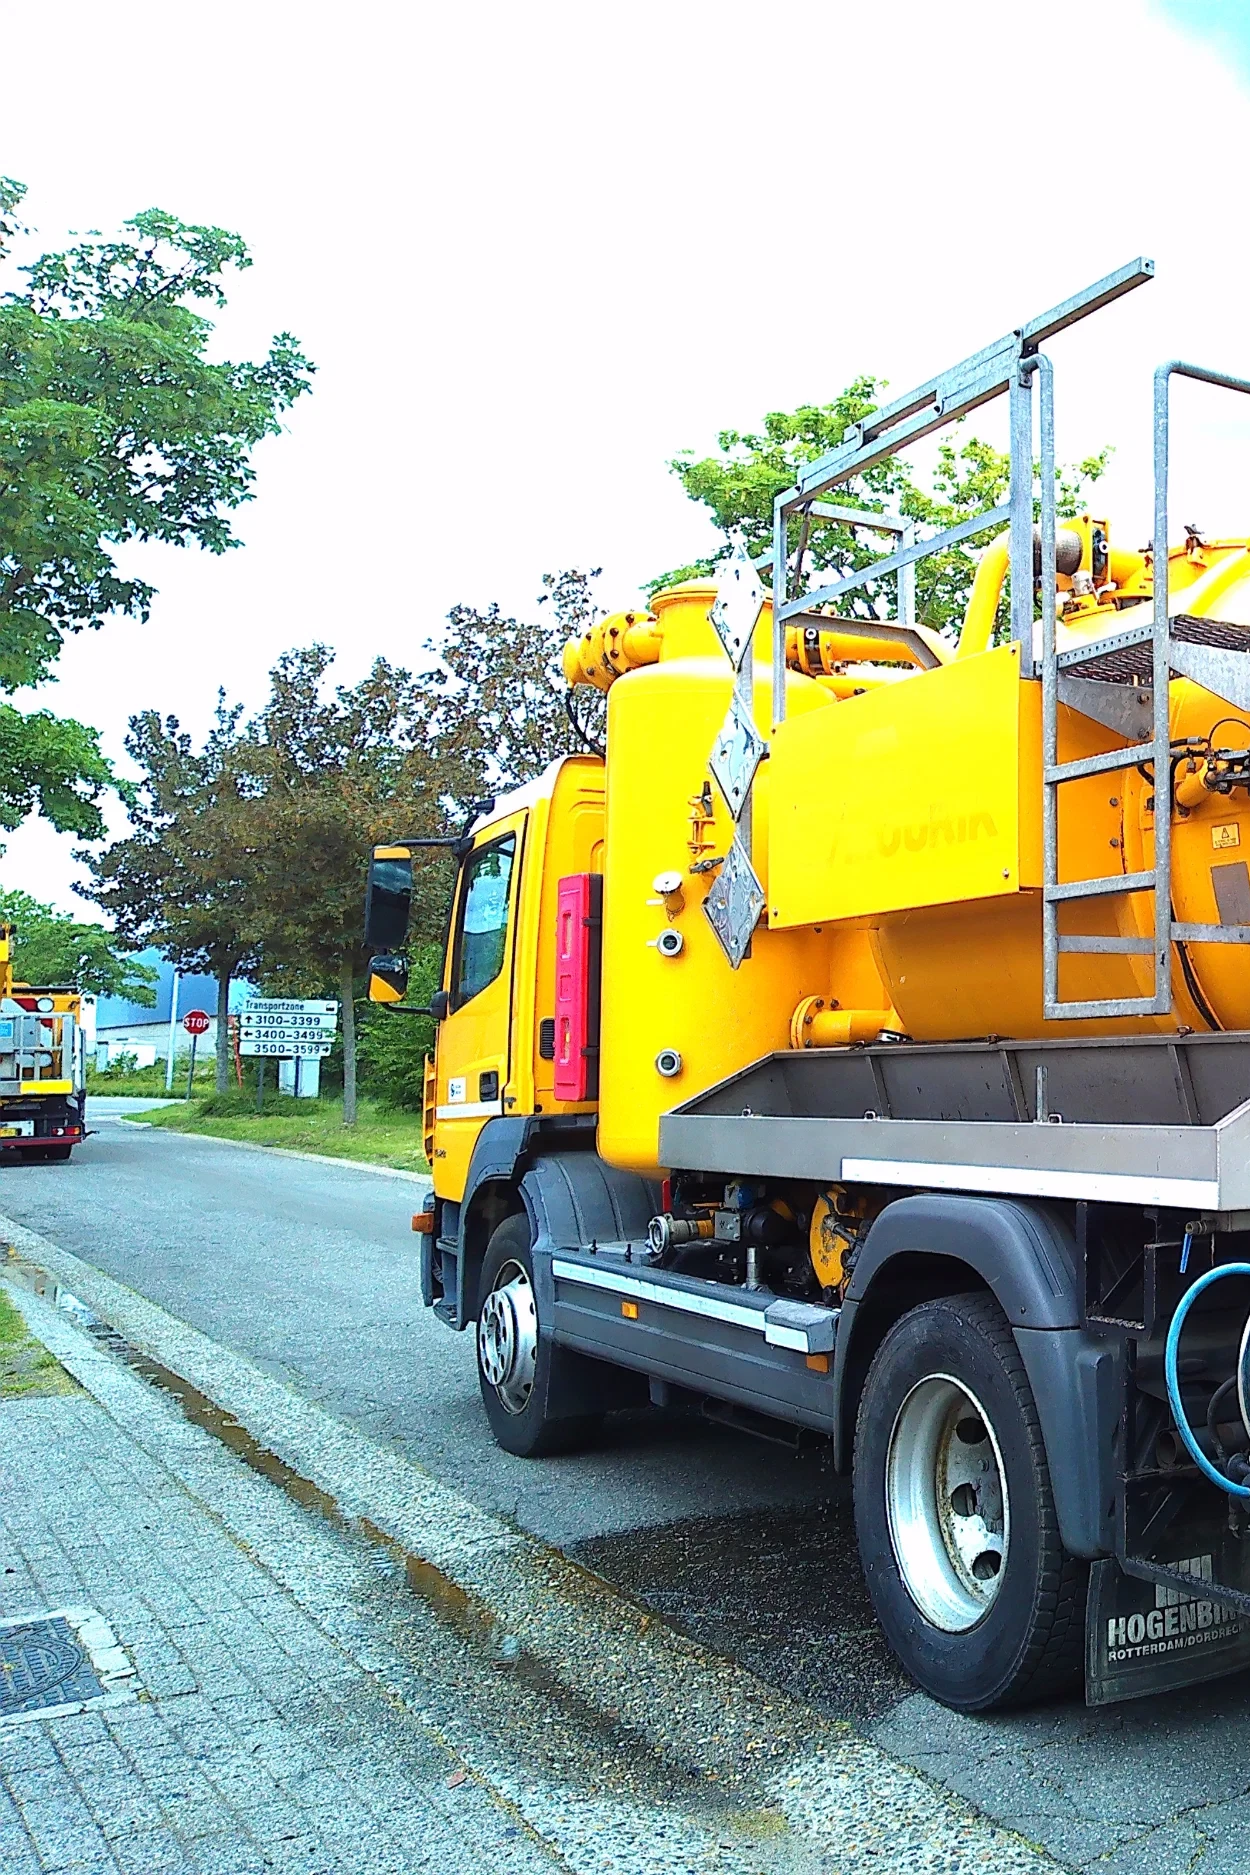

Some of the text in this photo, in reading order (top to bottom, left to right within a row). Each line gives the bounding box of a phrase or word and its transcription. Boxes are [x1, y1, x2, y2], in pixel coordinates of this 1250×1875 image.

[245, 999, 305, 1012] Transportzone
[183, 1018, 210, 1029] STOP
[255, 1015, 321, 1026] 3100-3399
[254, 1029, 323, 1040] 3400-3499
[254, 1043, 320, 1054] 3500-3599
[1107, 1600, 1240, 1647] HOGENBI
[1107, 1623, 1247, 1662] ROTTERDAM/DORDREC
